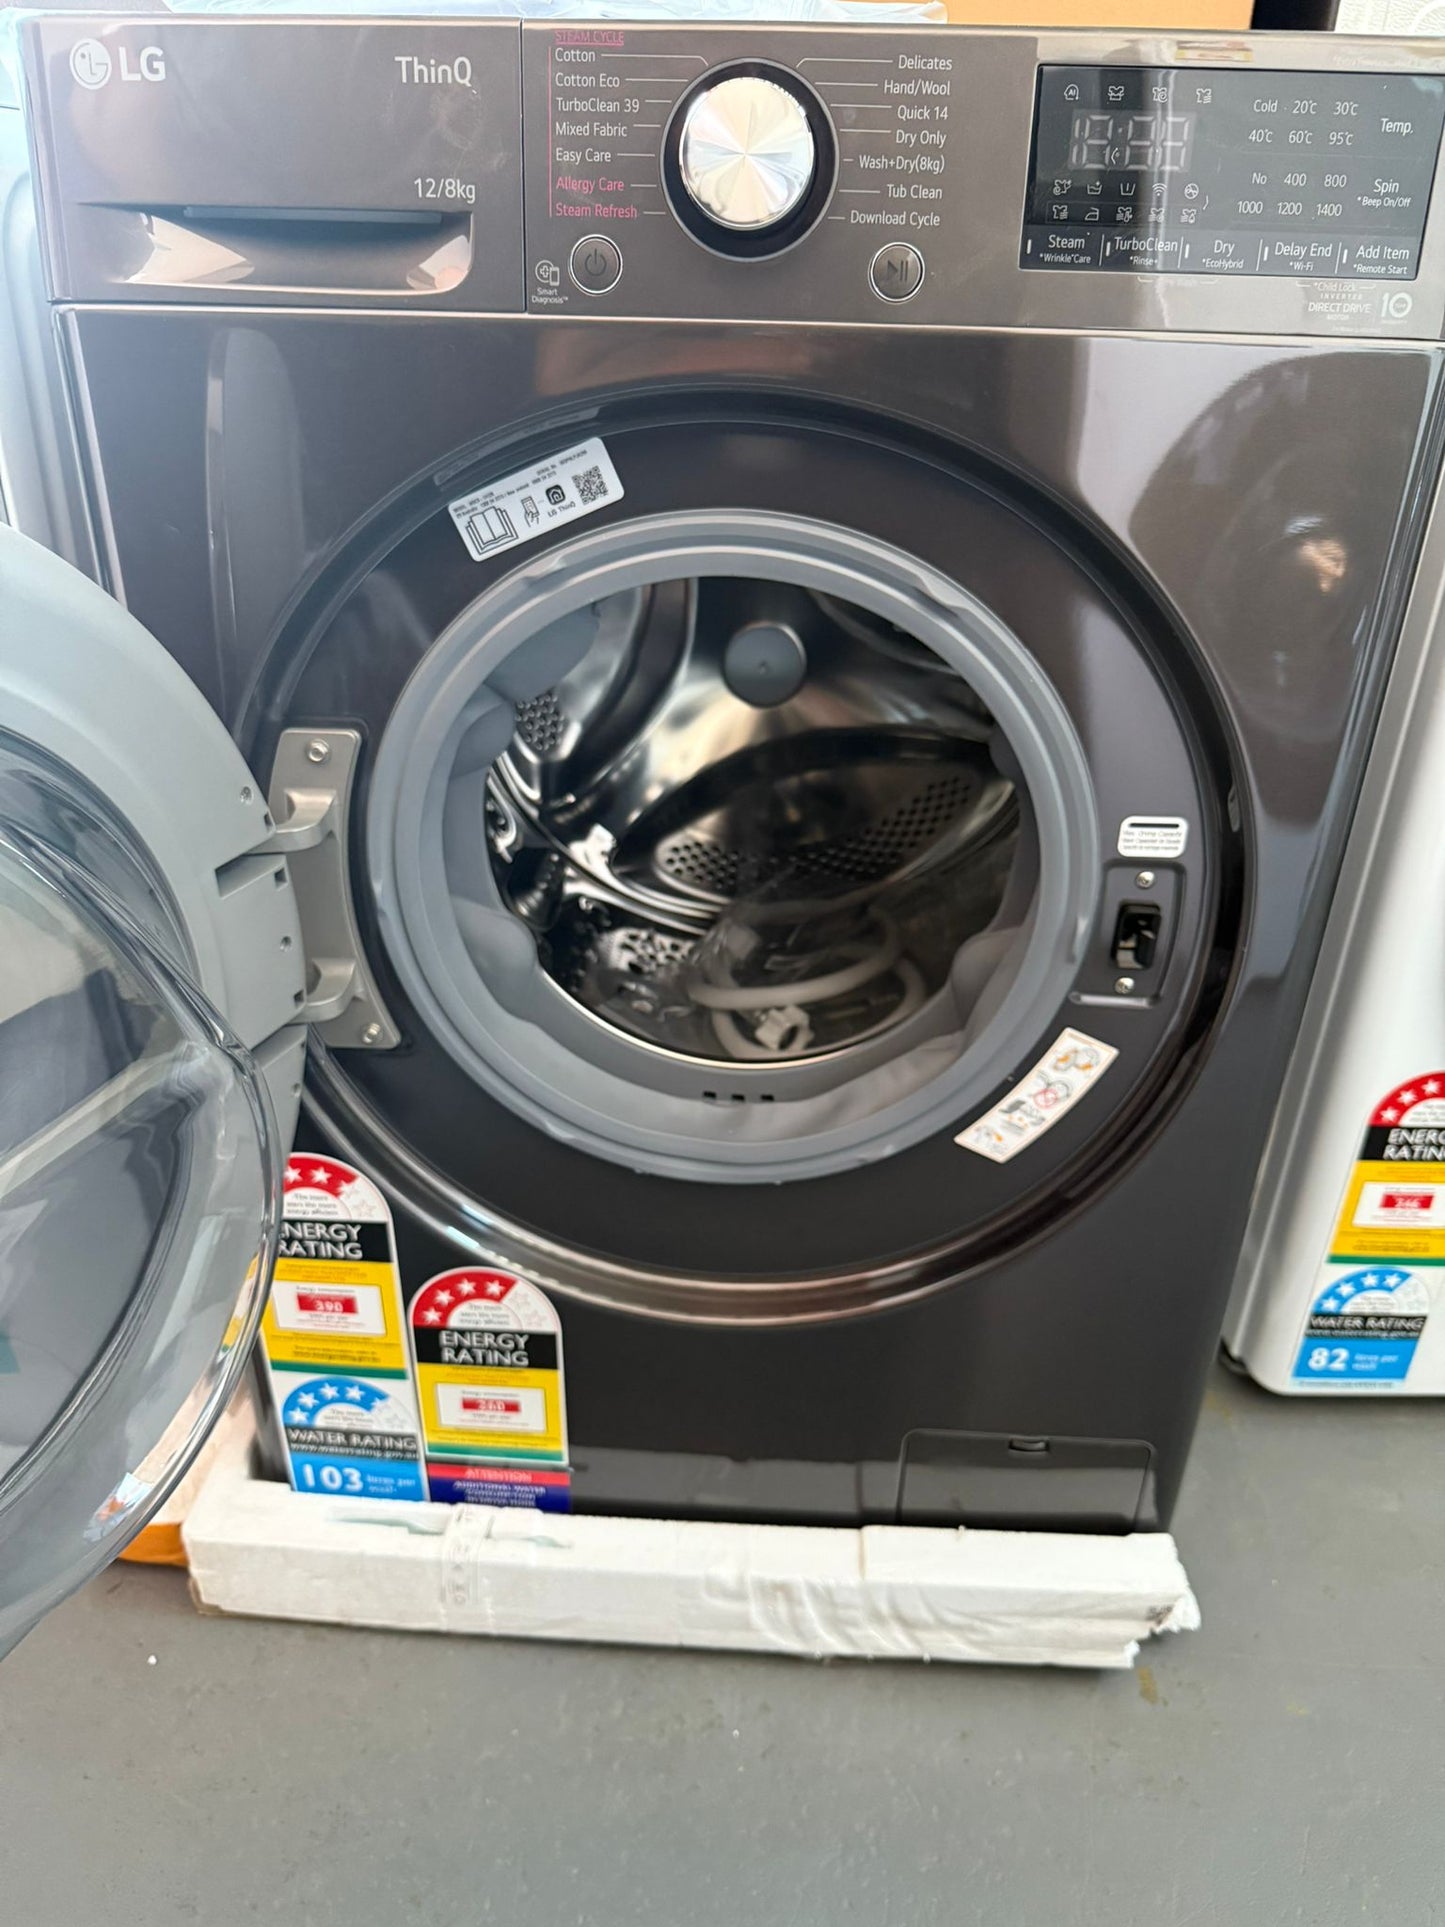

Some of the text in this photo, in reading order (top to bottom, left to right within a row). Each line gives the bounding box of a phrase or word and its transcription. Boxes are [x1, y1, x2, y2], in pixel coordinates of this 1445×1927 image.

[554, 31, 624, 46] STEAM CYCLE
[555, 48, 596, 63] Cotton
[898, 55, 953, 72] Delicates
[119, 47, 166, 82] LG
[395, 56, 475, 92] ThinQ
[555, 73, 620, 89] Cotton Eco
[884, 80, 951, 97] Hand/Wool
[556, 97, 640, 113] TurboClean 39
[897, 105, 949, 121] Quick 14
[1253, 100, 1278, 113] Cold
[555, 122, 628, 138] Mixed Fabric
[1380, 118, 1414, 137] Temp.
[896, 130, 947, 147] Dry Only
[555, 148, 611, 164] Easy Care
[858, 154, 945, 174] Wash+Dry(8kg)
[556, 177, 625, 194] Allergy Care
[1252, 172, 1268, 185] No
[1284, 173, 1307, 187] 400
[1324, 174, 1347, 188] 800
[414, 178, 476, 203] 12/8kg
[886, 184, 943, 200] Tub Clean
[1373, 178, 1400, 196] Spin
[1238, 201, 1263, 214] 1000
[1277, 202, 1302, 216] 1200
[1316, 203, 1343, 217] 1400
[1383, 196, 1412, 209] On/Off
[555, 203, 638, 219] Steam Refresh
[850, 210, 941, 229] Download Cycle
[1048, 234, 1085, 249] Steam
[1114, 236, 1178, 252] TurboClean
[1214, 240, 1235, 257] Dry
[1073, 252, 1092, 264] Care
[1274, 242, 1333, 261] Delay End
[1356, 245, 1410, 260] Add Item
[1387, 265, 1408, 275] Start
[1340, 282, 1357, 293] Lock
[1308, 302, 1372, 314] DIRECT DRIVE
[1383, 1145, 1445, 1160] RATIN
[279, 1221, 361, 1242] NERGY
[1311, 1316, 1424, 1331] WATER RATING
[439, 1330, 529, 1351] ENERGY
[440, 1347, 530, 1367] RATING
[1308, 1347, 1349, 1371] 82
[289, 1428, 348, 1445] WATER
[349, 1434, 418, 1450] RATING
[303, 1463, 364, 1492] 103
